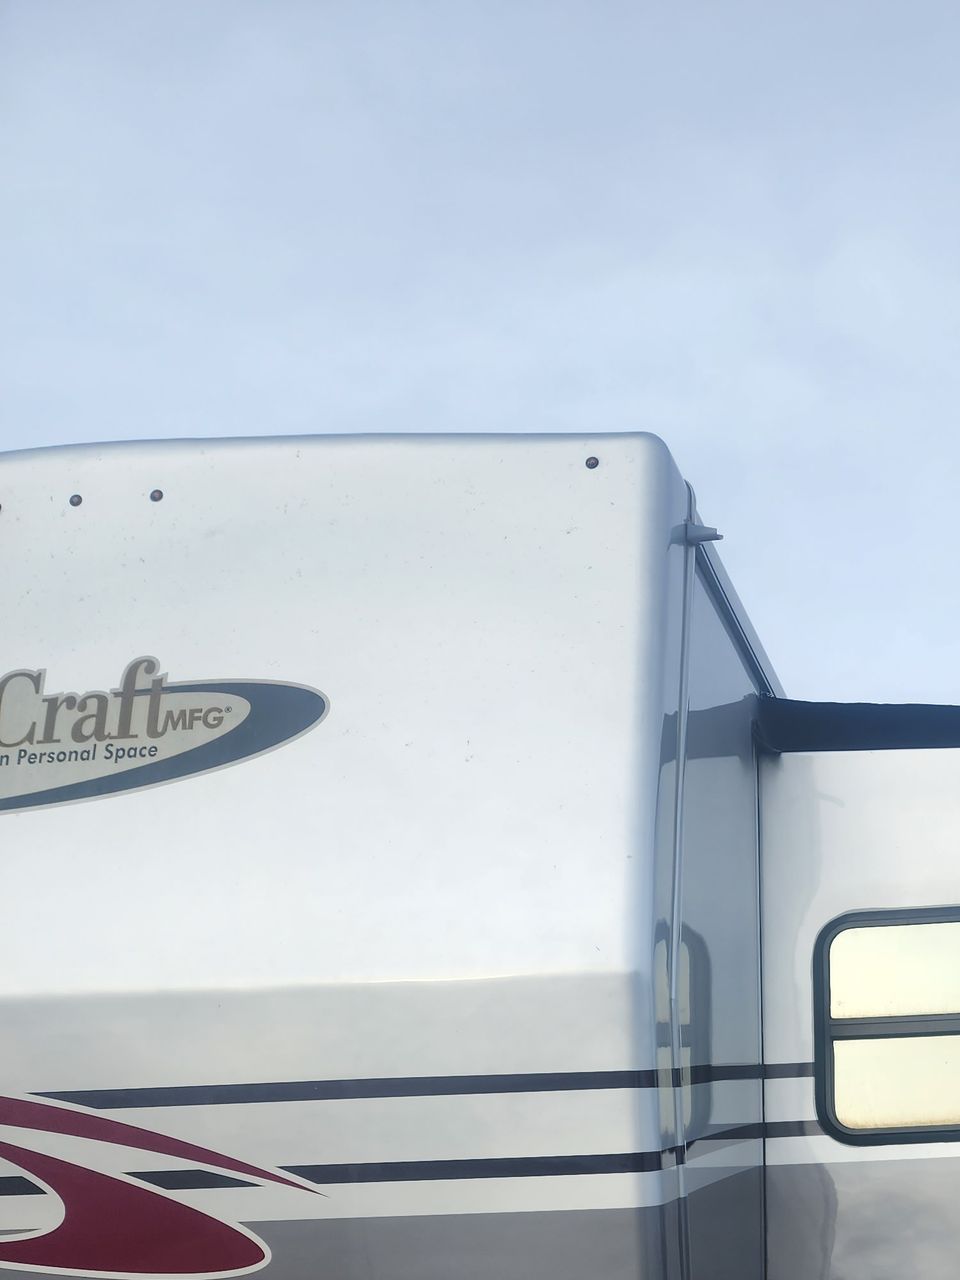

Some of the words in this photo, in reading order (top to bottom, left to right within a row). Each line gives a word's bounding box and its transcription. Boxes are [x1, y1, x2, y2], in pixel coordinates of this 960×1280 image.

[0, 658, 168, 748] Craft
[17, 744, 97, 765] Personal
[104, 743, 158, 763] Space
